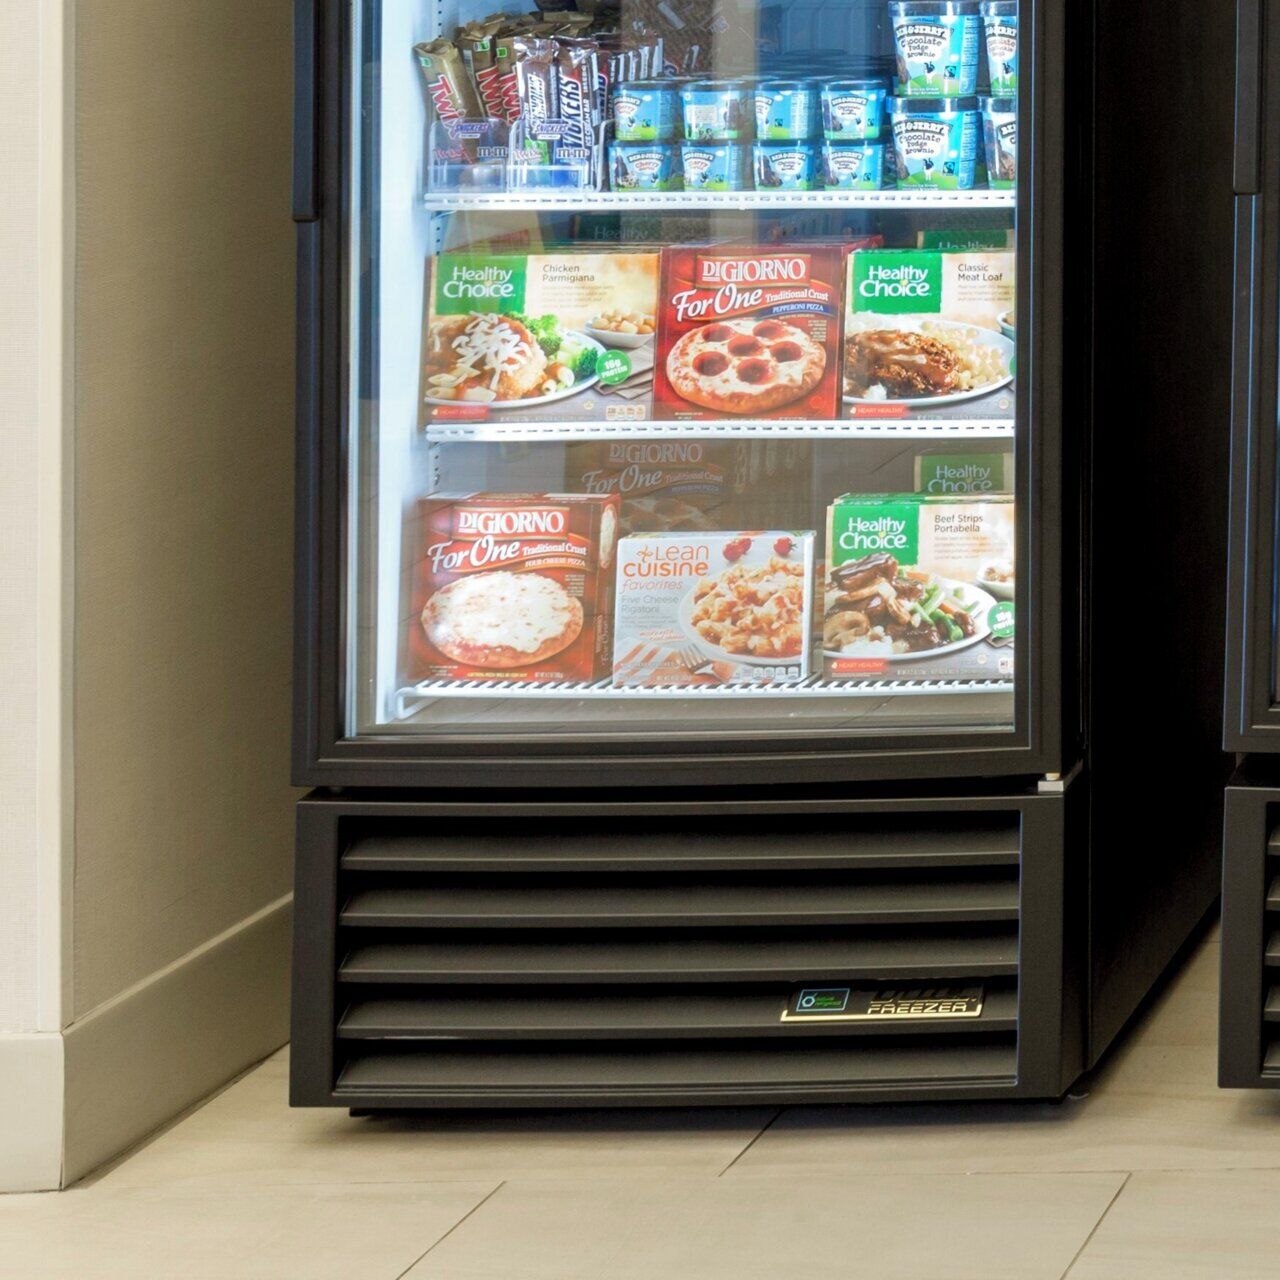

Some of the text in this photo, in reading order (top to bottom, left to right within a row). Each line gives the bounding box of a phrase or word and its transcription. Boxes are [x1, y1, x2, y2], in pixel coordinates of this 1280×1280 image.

[900, 37, 942, 47] Chocolate
[899, 134, 941, 144] Chocolate
[543, 264, 580, 273] Chicken
[869, 265, 928, 283] Healthy
[958, 264, 989, 272] Classic
[453, 266, 512, 285] Healthy
[542, 273, 595, 284] Parmigiana
[958, 273, 1003, 281] Meat Loaf
[443, 281, 513, 298] Choice
[859, 279, 930, 297] Choice
[672, 283, 763, 322] For One
[765, 289, 829, 303] Traditional Crust
[773, 304, 824, 313] PEPPERONI PIZZA
[935, 514, 983, 524] Beef Strips
[848, 517, 906, 535] Healthy
[935, 524, 980, 533] Portabella
[839, 532, 907, 549] Choice
[427, 535, 520, 573] For One
[522, 544, 567, 556] Traditional
[654, 545, 709, 560] Lean
[624, 562, 709, 577] cuisine
[620, 580, 683, 594] favorites
[643, 595, 679, 604] Cheese
[621, 605, 660, 615] Rigatoni
